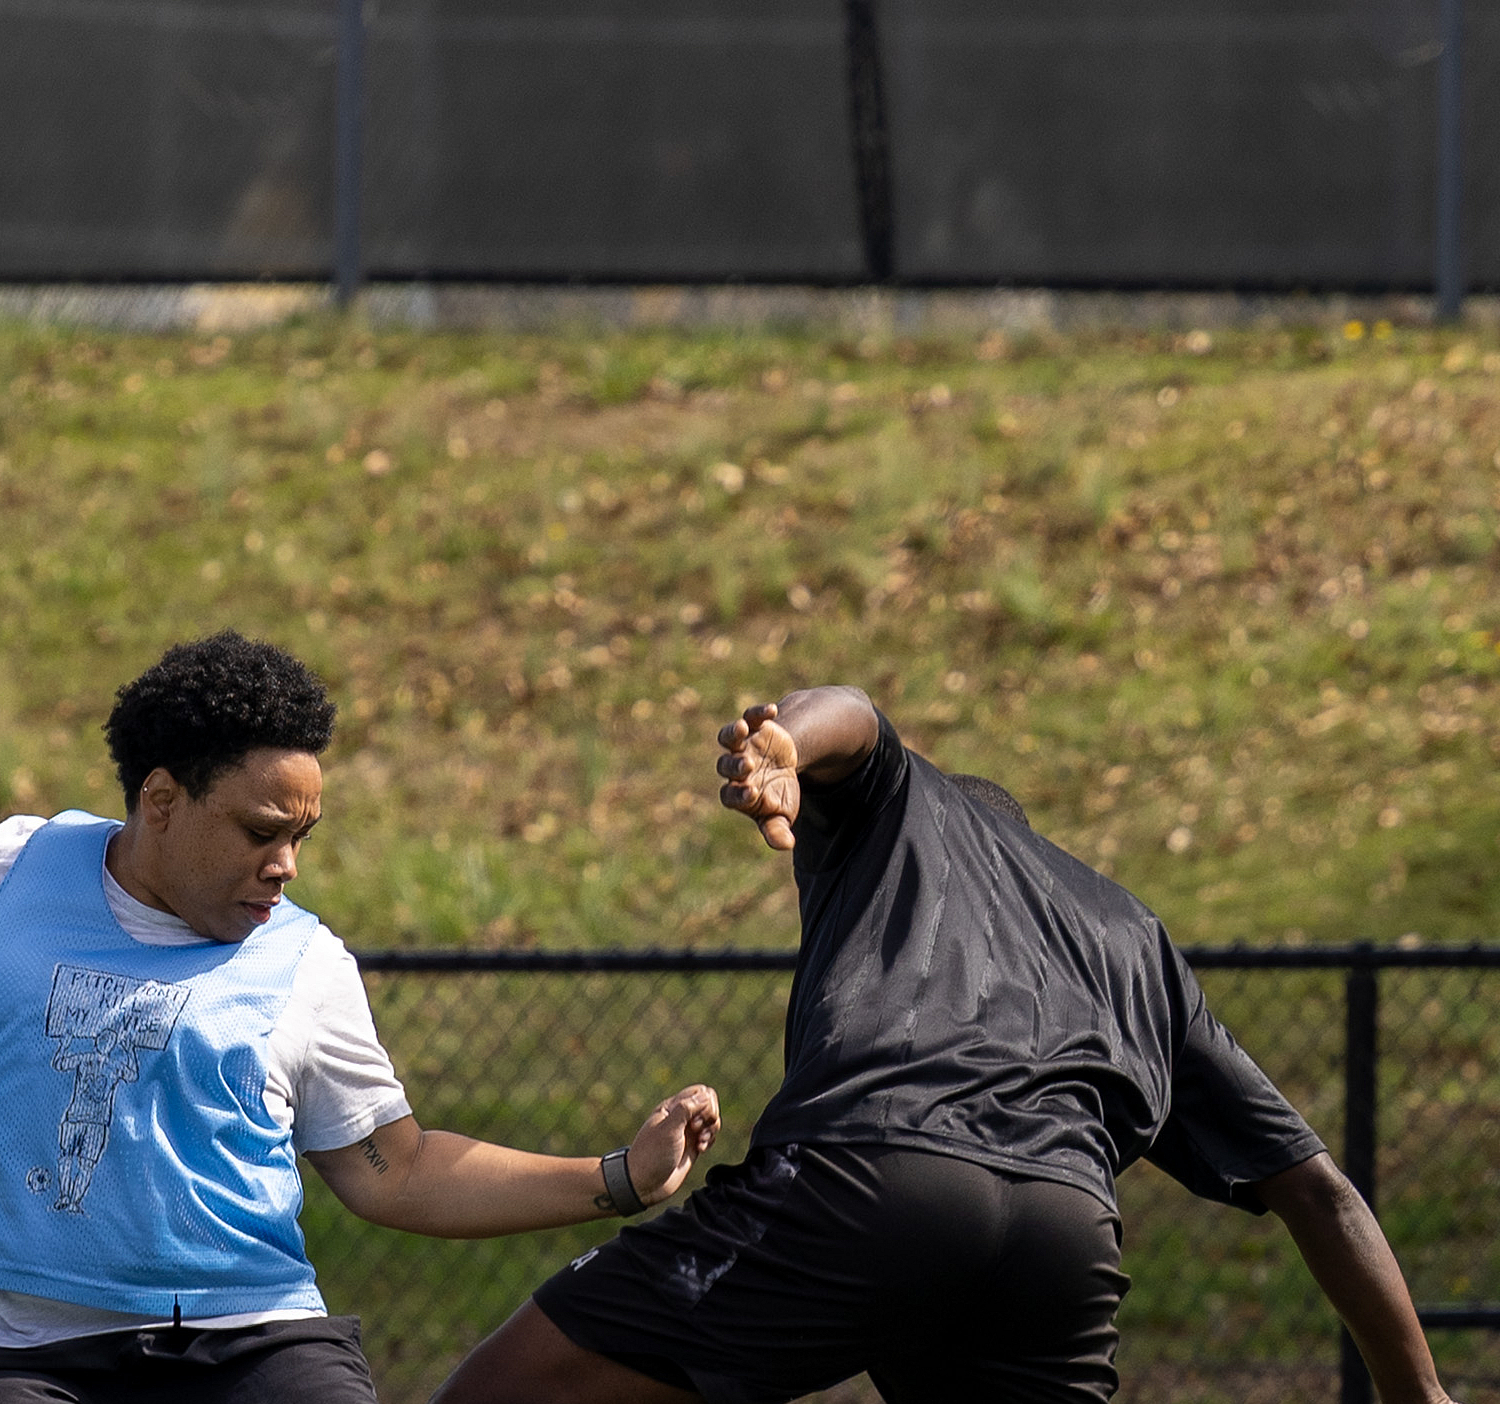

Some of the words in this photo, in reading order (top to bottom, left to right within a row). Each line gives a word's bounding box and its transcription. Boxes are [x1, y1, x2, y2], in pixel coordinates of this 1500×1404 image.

[71, 971, 127, 994] PITCH
[65, 1006, 90, 1024] MY
[121, 1011, 161, 1033] VIBE
